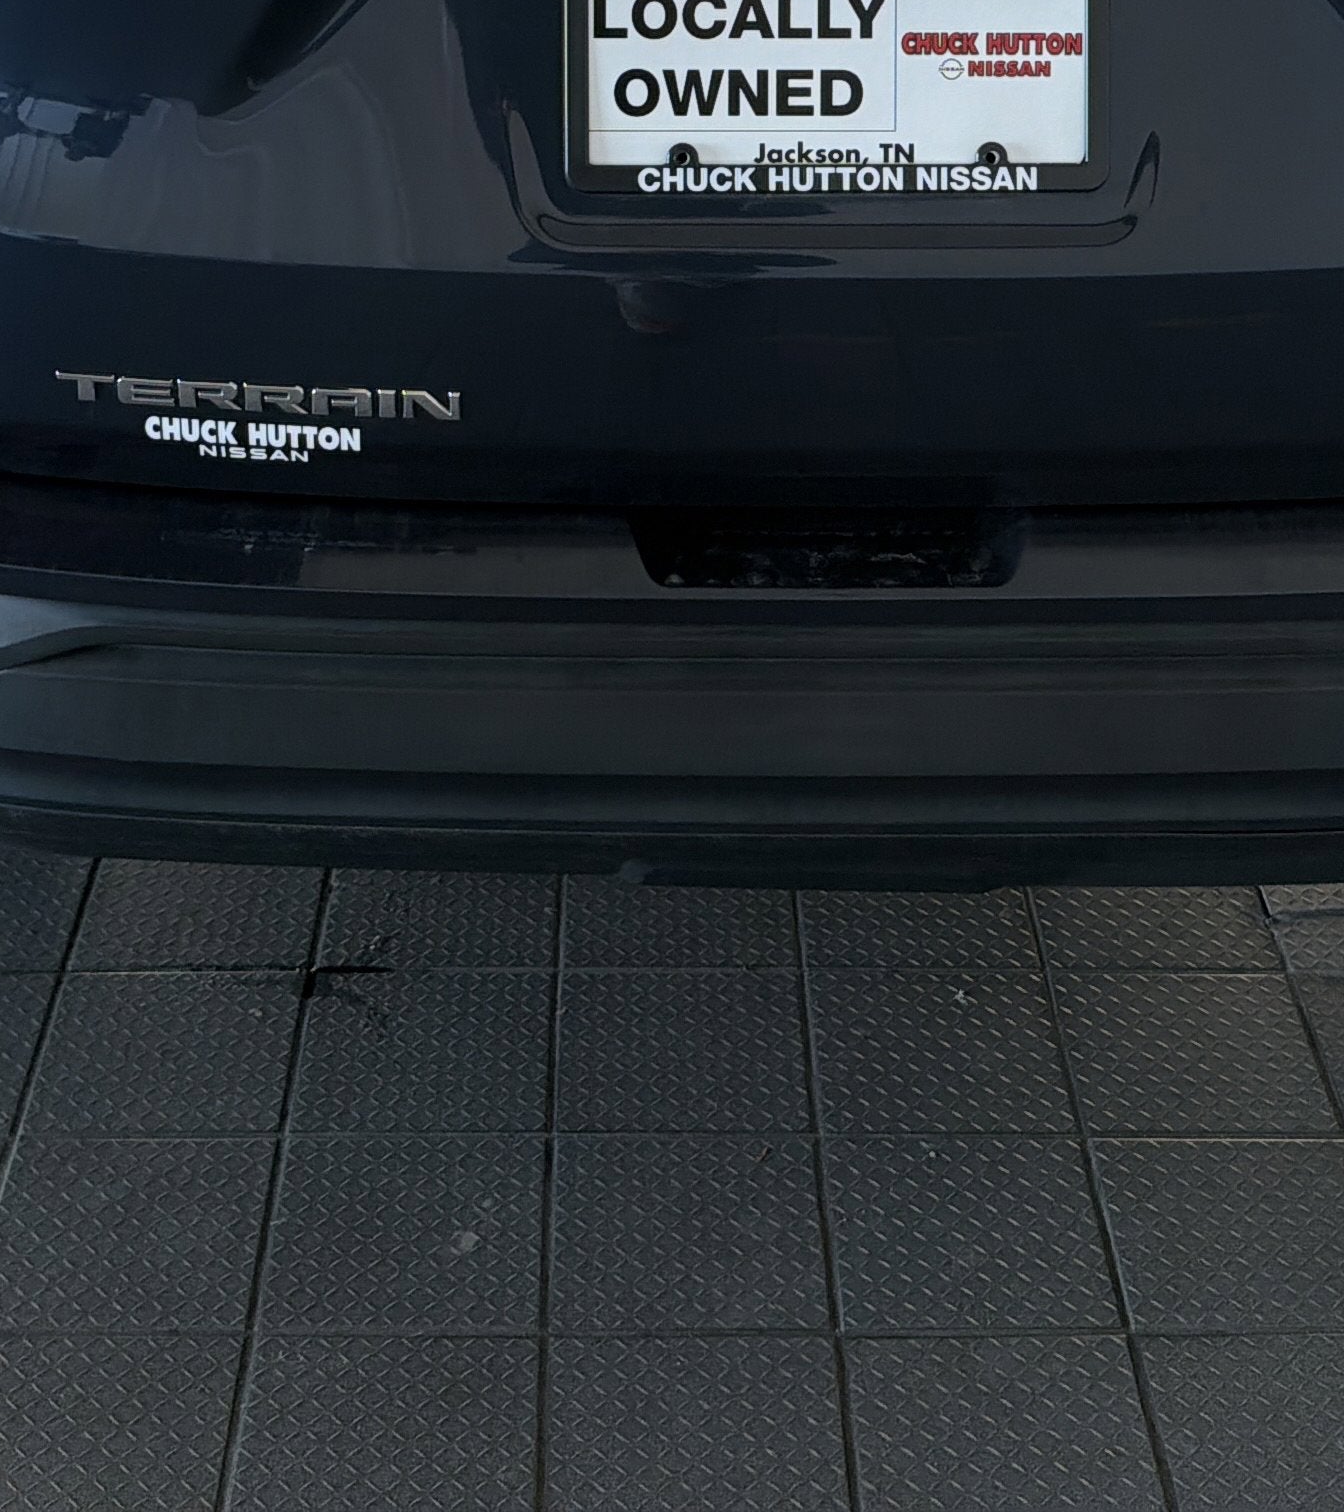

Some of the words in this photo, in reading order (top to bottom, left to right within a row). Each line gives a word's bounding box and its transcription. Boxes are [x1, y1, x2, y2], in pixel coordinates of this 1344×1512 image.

[901, 32, 979, 56] CHUCK
[986, 32, 1083, 56] HUTTON
[968, 60, 1051, 77] NISSAN
[613, 69, 864, 117] OWNED
[754, 141, 870, 166] Jackson,
[879, 143, 916, 163] TN
[637, 166, 757, 192] CHUCK
[768, 166, 904, 192] HUTTON
[916, 166, 1038, 192] NISSAN
[55, 369, 461, 421] TERRAIN
[144, 415, 238, 446] CHUCK
[248, 422, 362, 452] HUTTON
[199, 444, 310, 464] NISSAN
